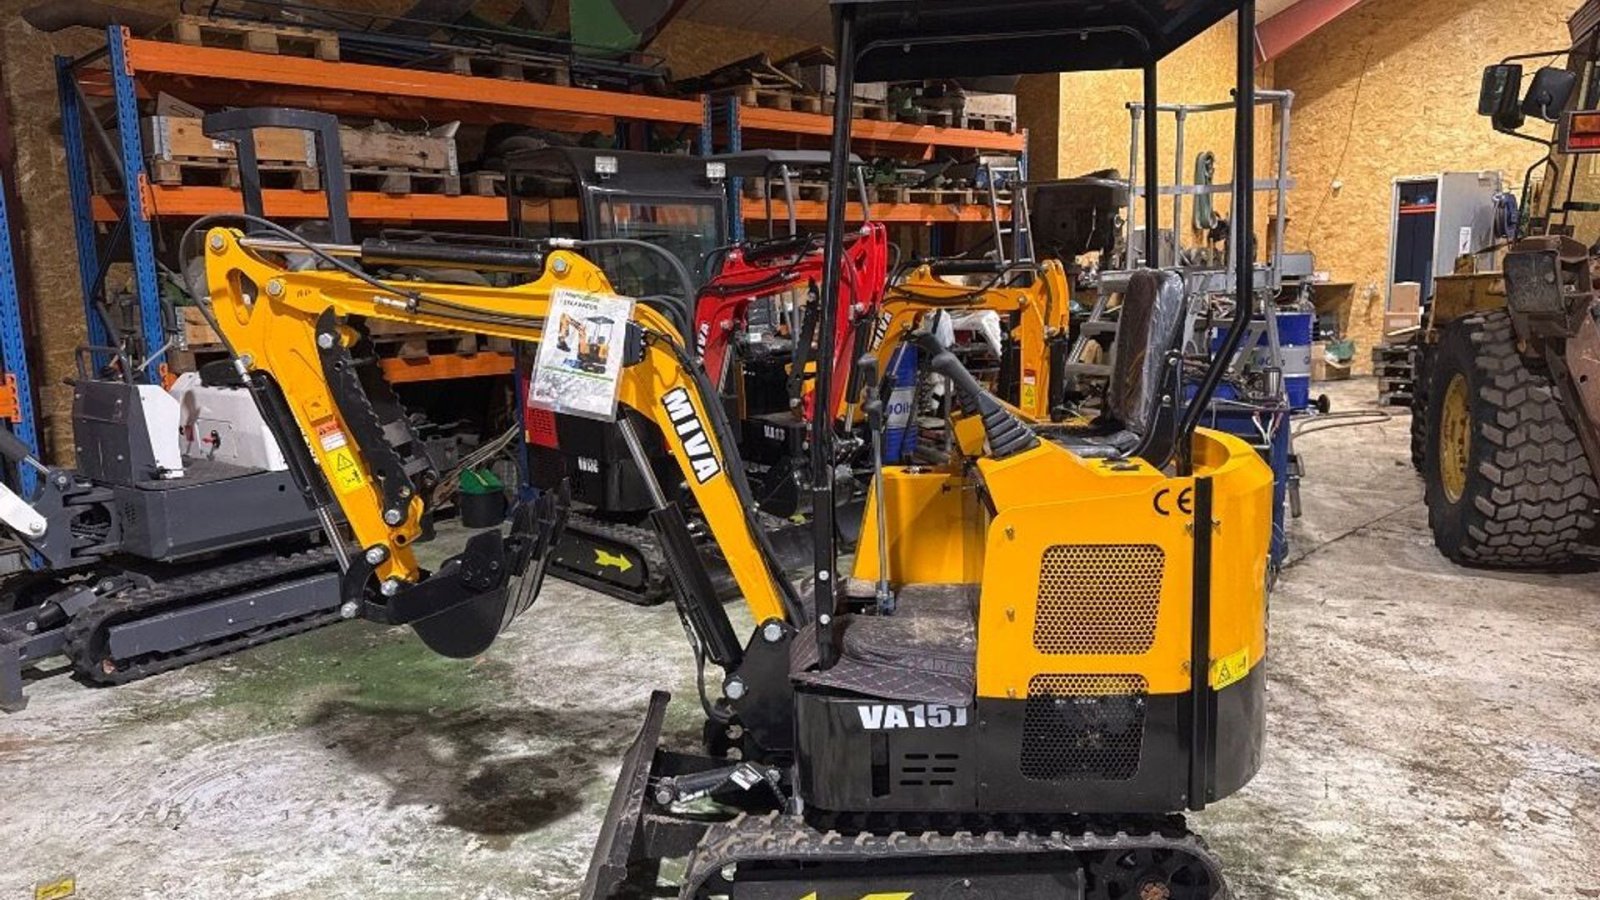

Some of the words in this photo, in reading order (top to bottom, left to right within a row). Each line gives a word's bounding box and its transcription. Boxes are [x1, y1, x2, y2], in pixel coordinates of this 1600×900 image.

[662, 387, 721, 484] MIVA
[1152, 486, 1193, 517] CE
[857, 704, 968, 730] VA15J
